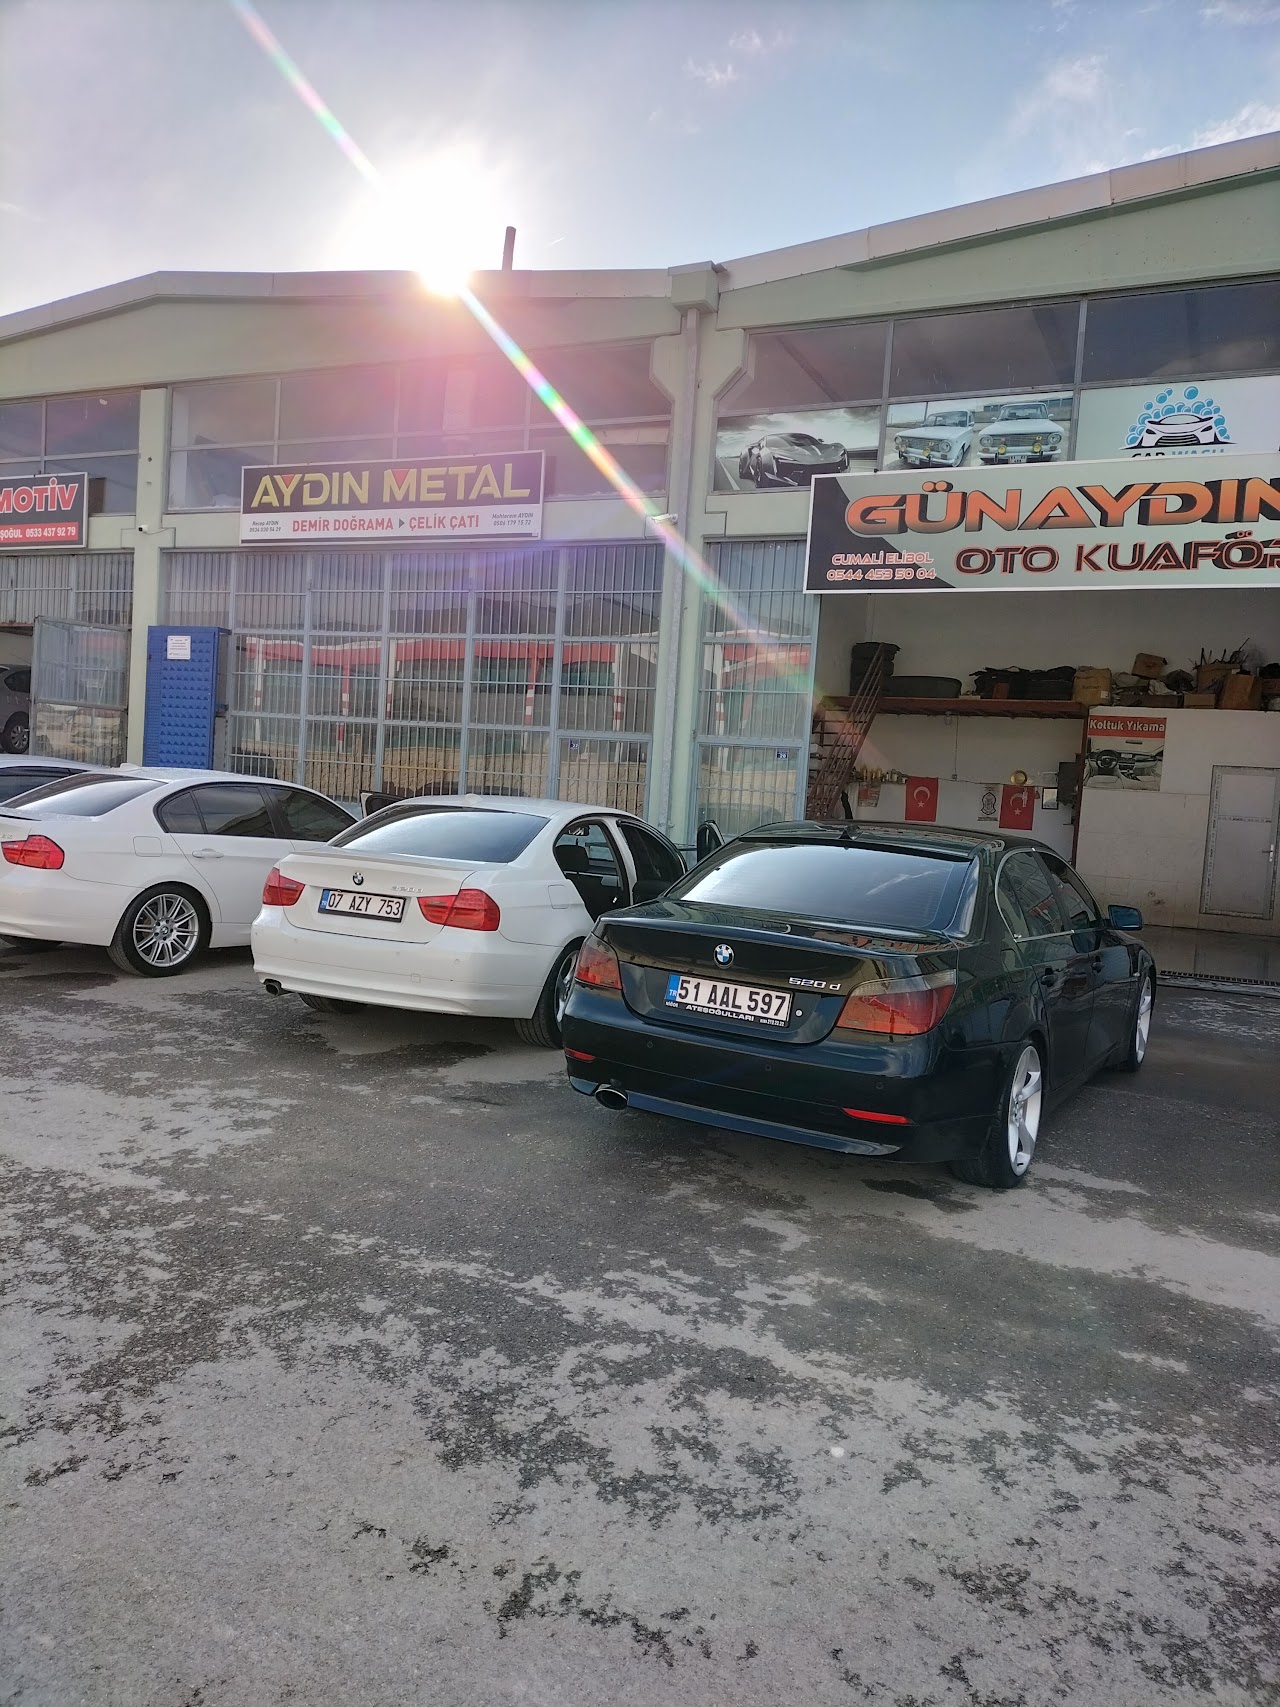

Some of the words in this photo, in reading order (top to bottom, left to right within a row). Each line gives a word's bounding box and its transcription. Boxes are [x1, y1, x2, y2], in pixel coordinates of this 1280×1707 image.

[251, 471, 369, 508] AYDIN
[383, 463, 530, 503] METAL
[846, 477, 1280, 535] GÜNAYDIN
[292, 517, 330, 532] DEMİR
[333, 515, 394, 531] DOĞRAMA
[409, 513, 446, 531] ÇELİK
[449, 514, 479, 530] ÇATI
[26, 528, 42, 538] 0533
[43, 527, 55, 537] 437
[57, 527, 66, 536] 92
[67, 526, 76, 536] 79
[831, 550, 884, 566] CUMALİ
[885, 549, 934, 565] ELİBOL
[956, 544, 1060, 575] OTO
[826, 569, 863, 581] 0544
[864, 568, 893, 580] 453
[894, 567, 915, 580] 50
[916, 567, 936, 579] 04
[1089, 719, 1124, 731] Koltuk
[1126, 720, 1165, 732] Yıkama
[328, 893, 343, 909] 07
[348, 895, 372, 912] AZY
[377, 898, 401, 916] 753
[789, 976, 827, 989] 520
[829, 983, 841, 991] d
[669, 989, 677, 997] TR
[678, 979, 701, 1002] 51
[707, 984, 742, 1010] AAL
[747, 990, 787, 1017] 597
